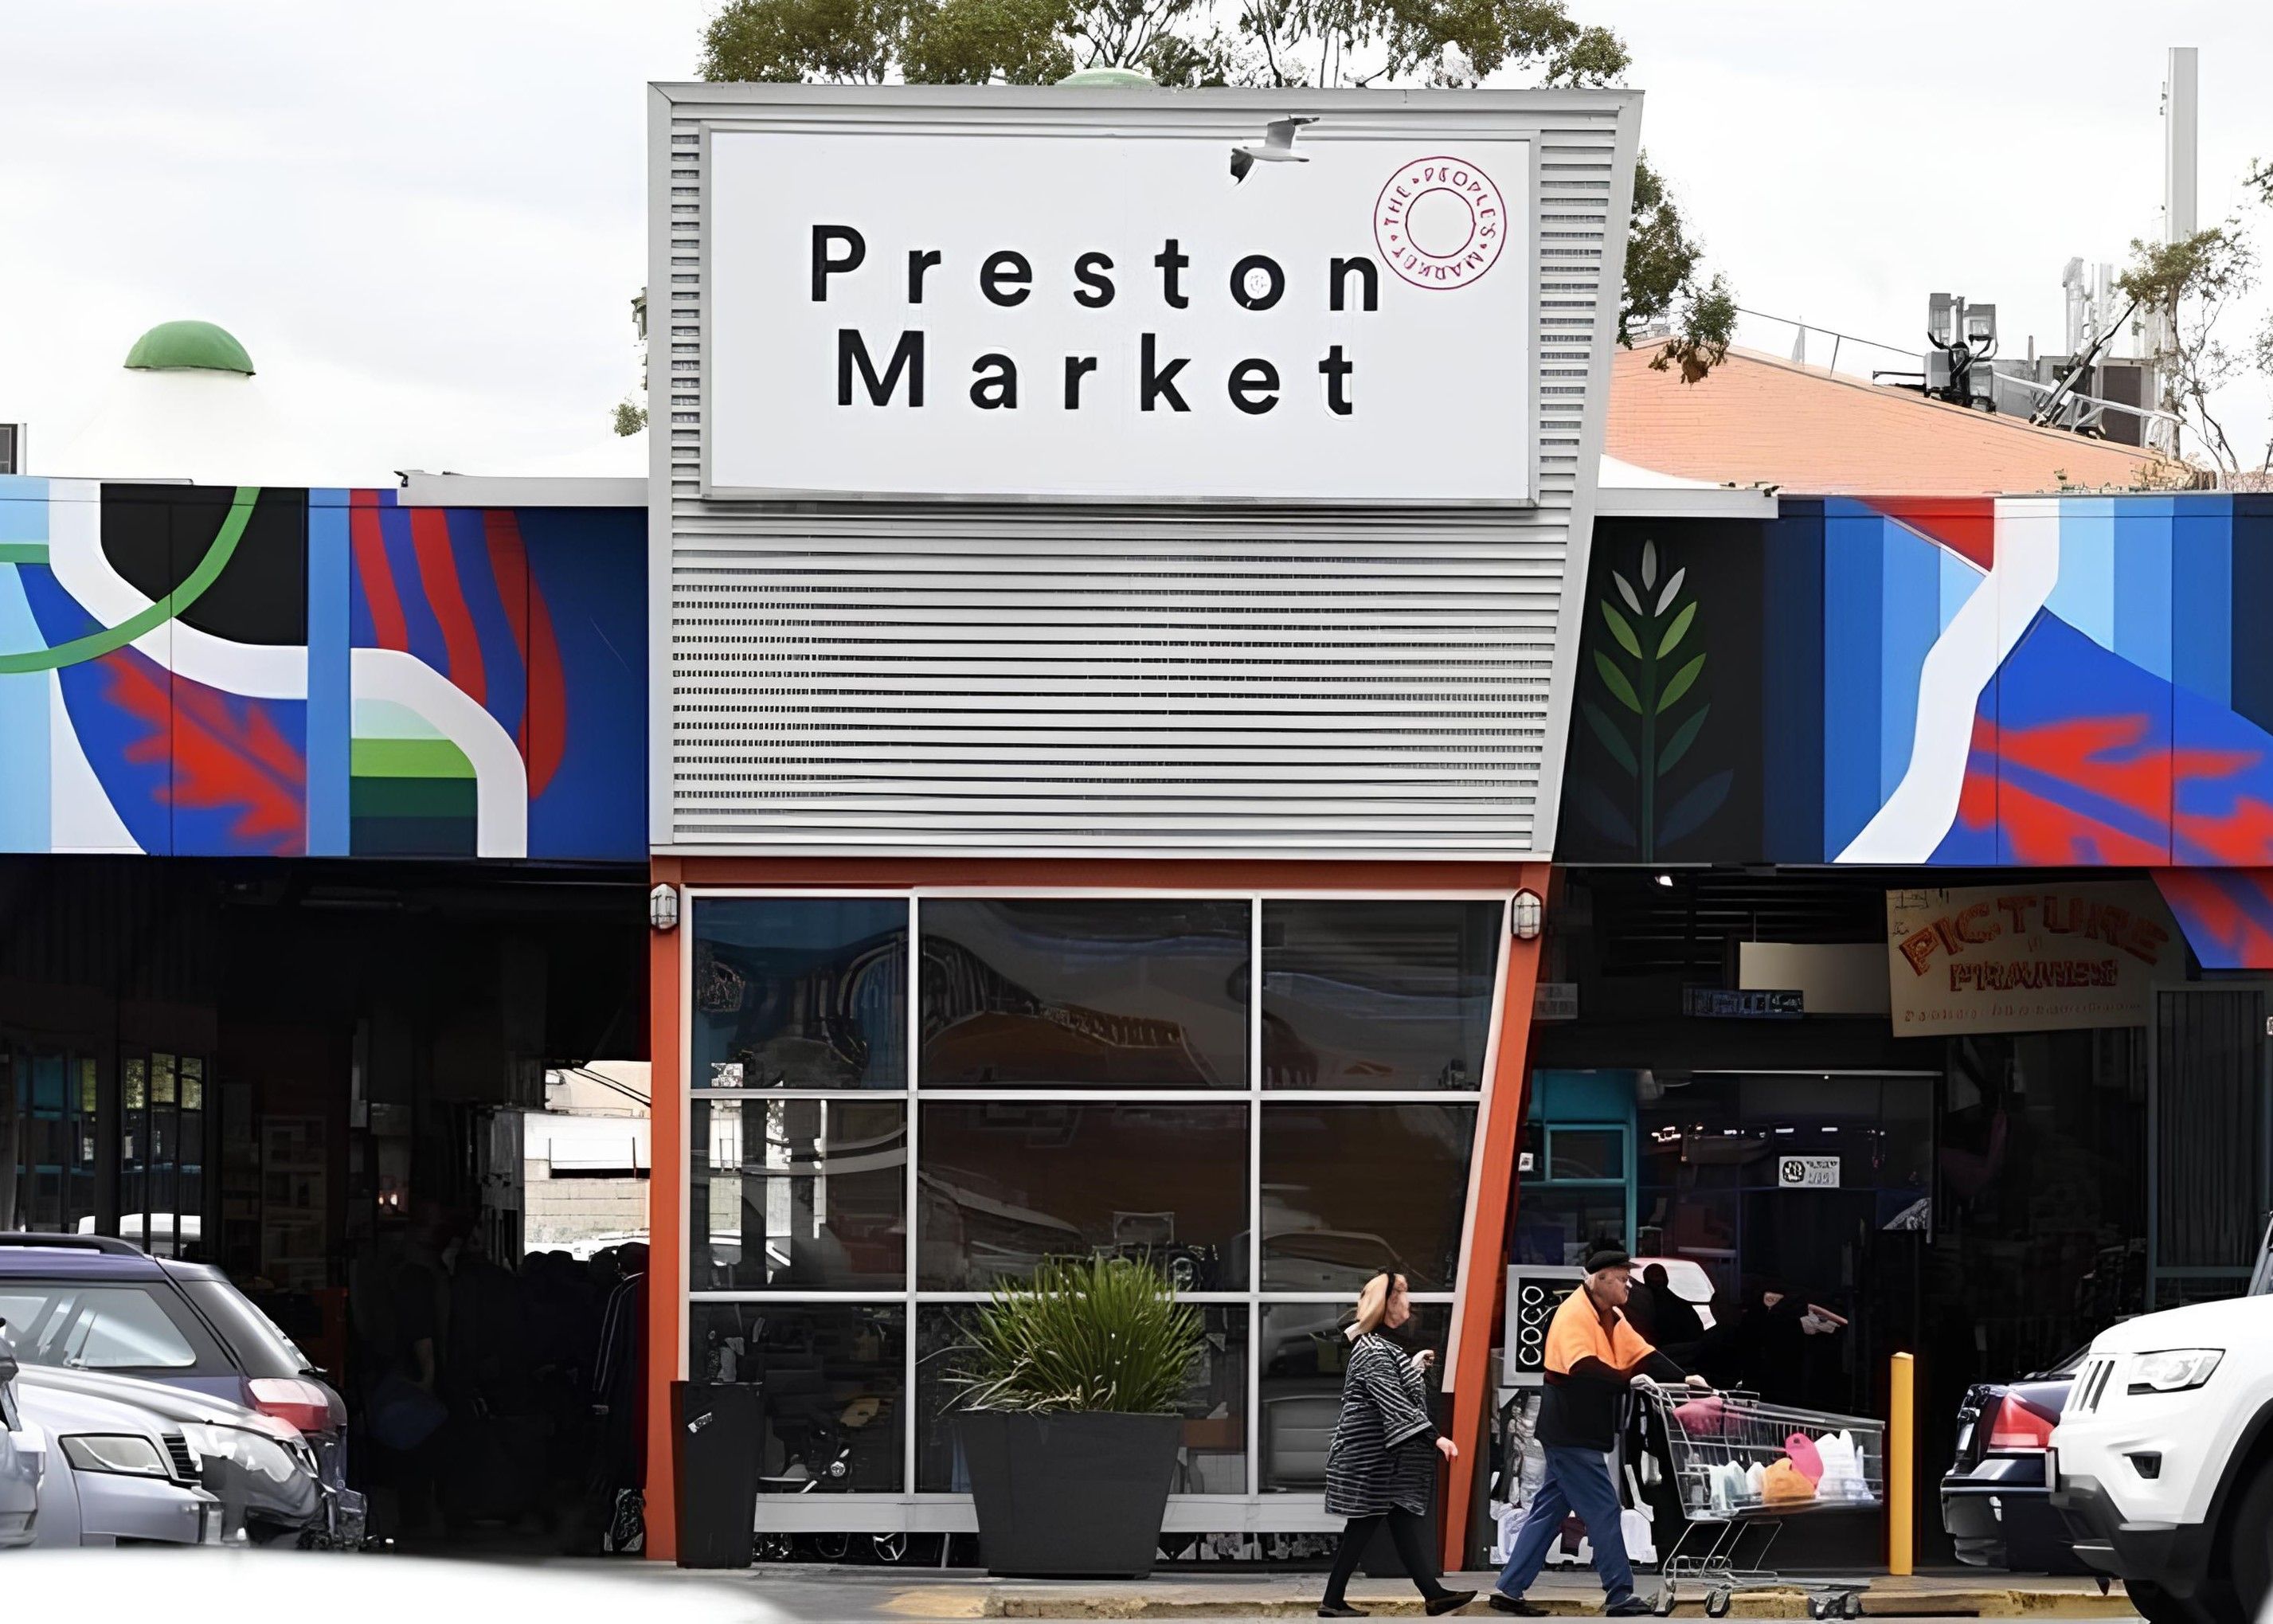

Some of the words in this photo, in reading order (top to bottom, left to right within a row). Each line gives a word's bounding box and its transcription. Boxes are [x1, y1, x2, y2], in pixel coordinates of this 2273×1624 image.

[812, 225, 1377, 311] Preston
[839, 329, 1352, 415] Market
[1899, 895, 2169, 976] PICTURE
